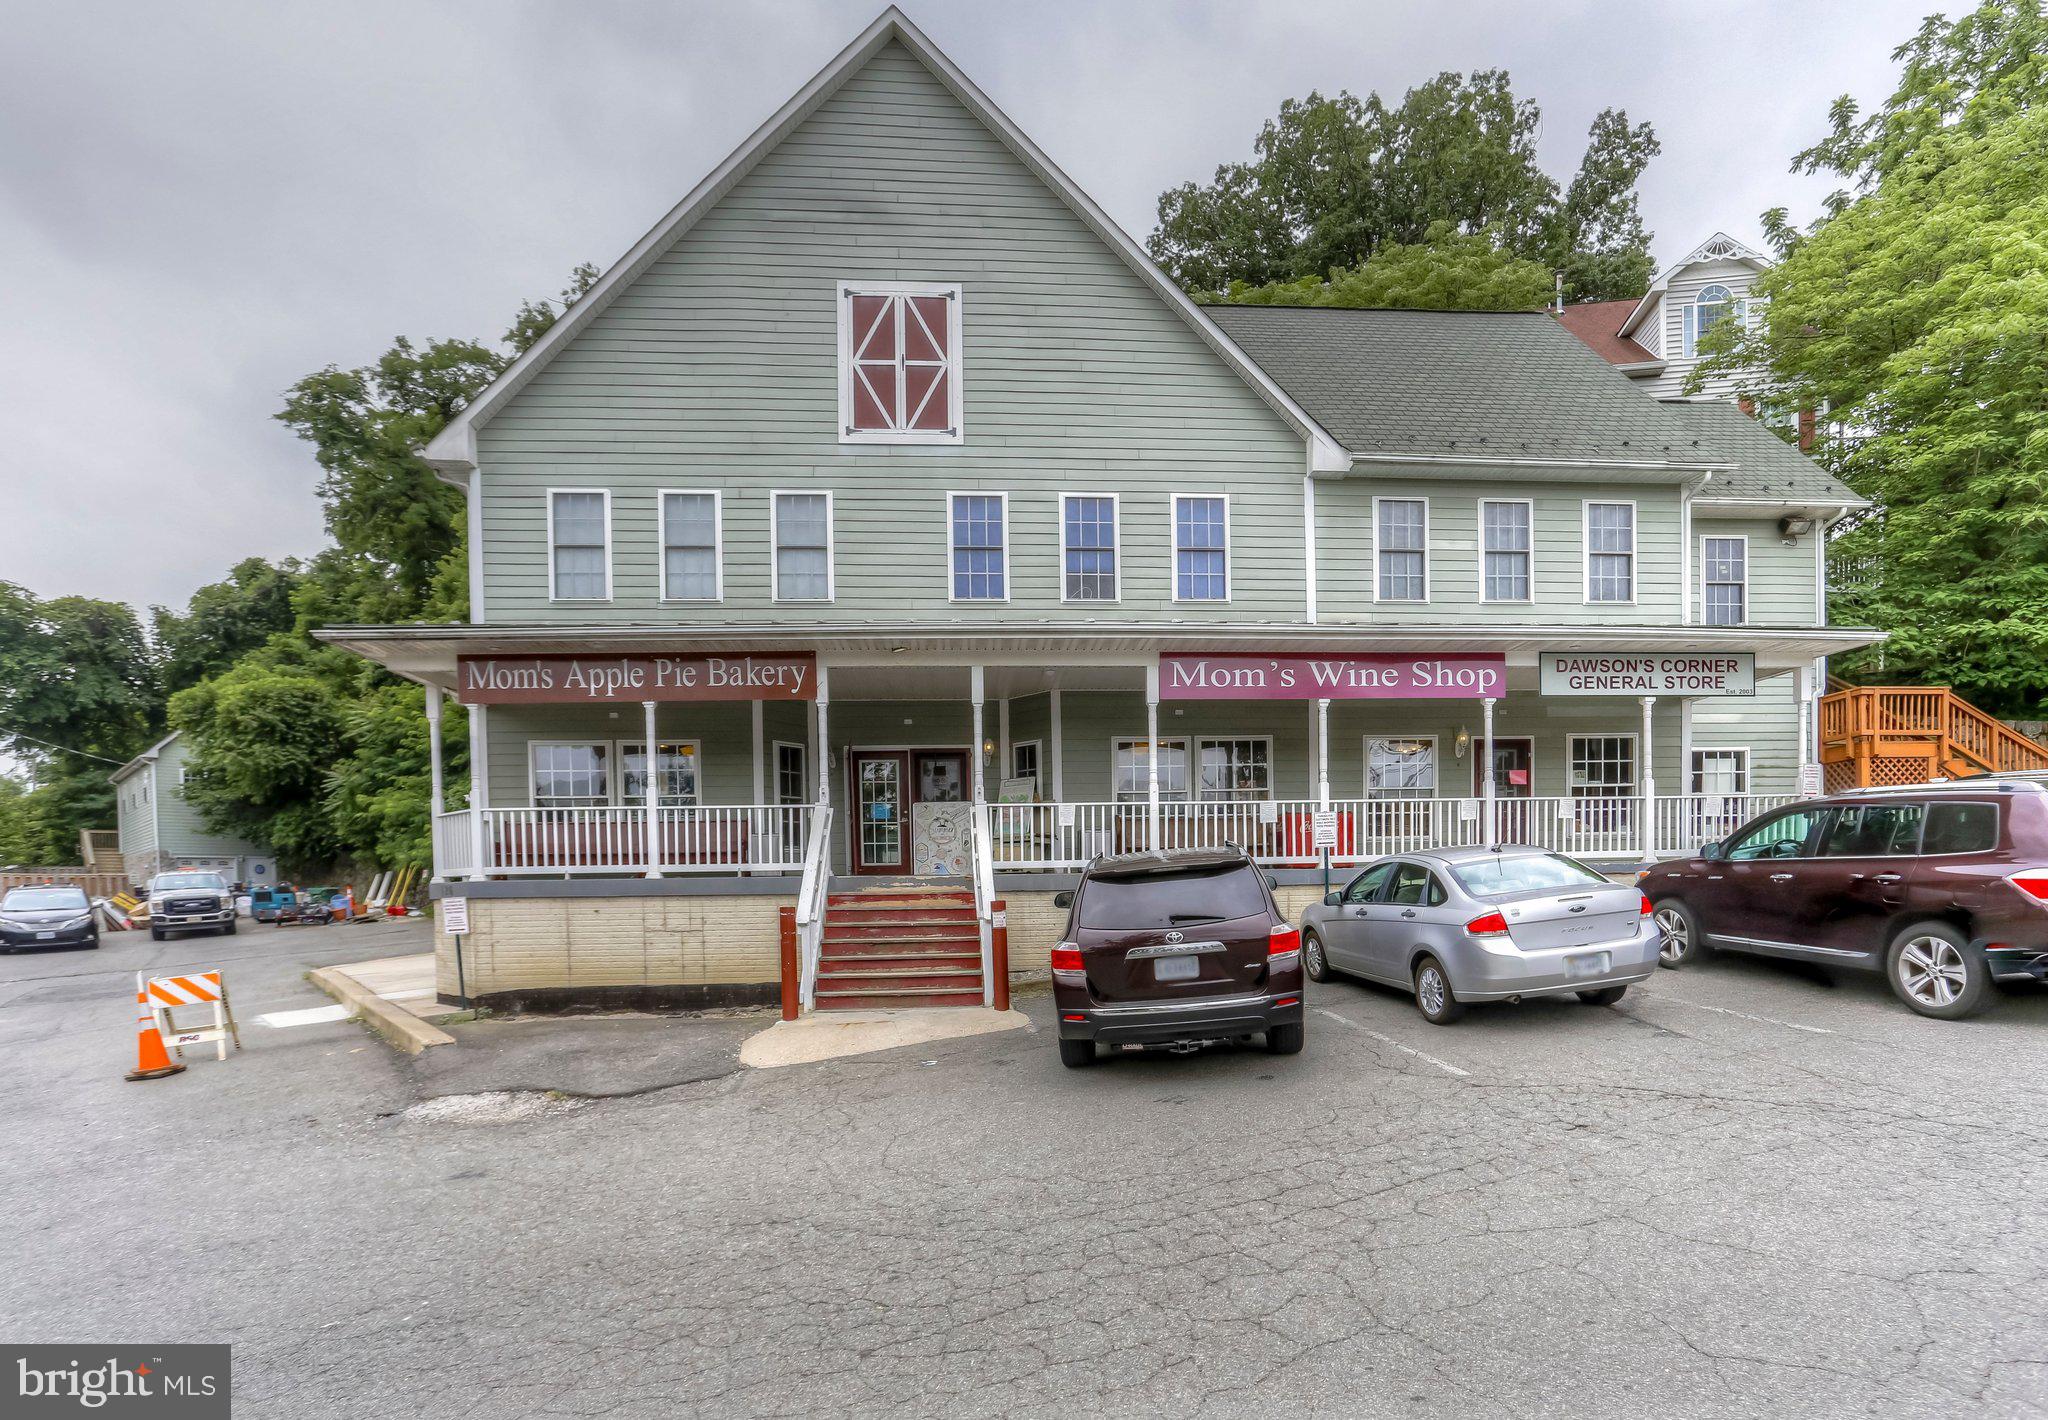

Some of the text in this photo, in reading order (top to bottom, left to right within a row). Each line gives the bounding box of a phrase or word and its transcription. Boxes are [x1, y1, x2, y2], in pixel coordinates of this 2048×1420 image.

[466, 656, 807, 697] Mom's Apple Pie Bakery
[1168, 660, 1498, 694] Mom's Wine Shop
[1555, 659, 1739, 673] DAWSON'S CORNER
[1569, 675, 1726, 690] GENERAL STORE
